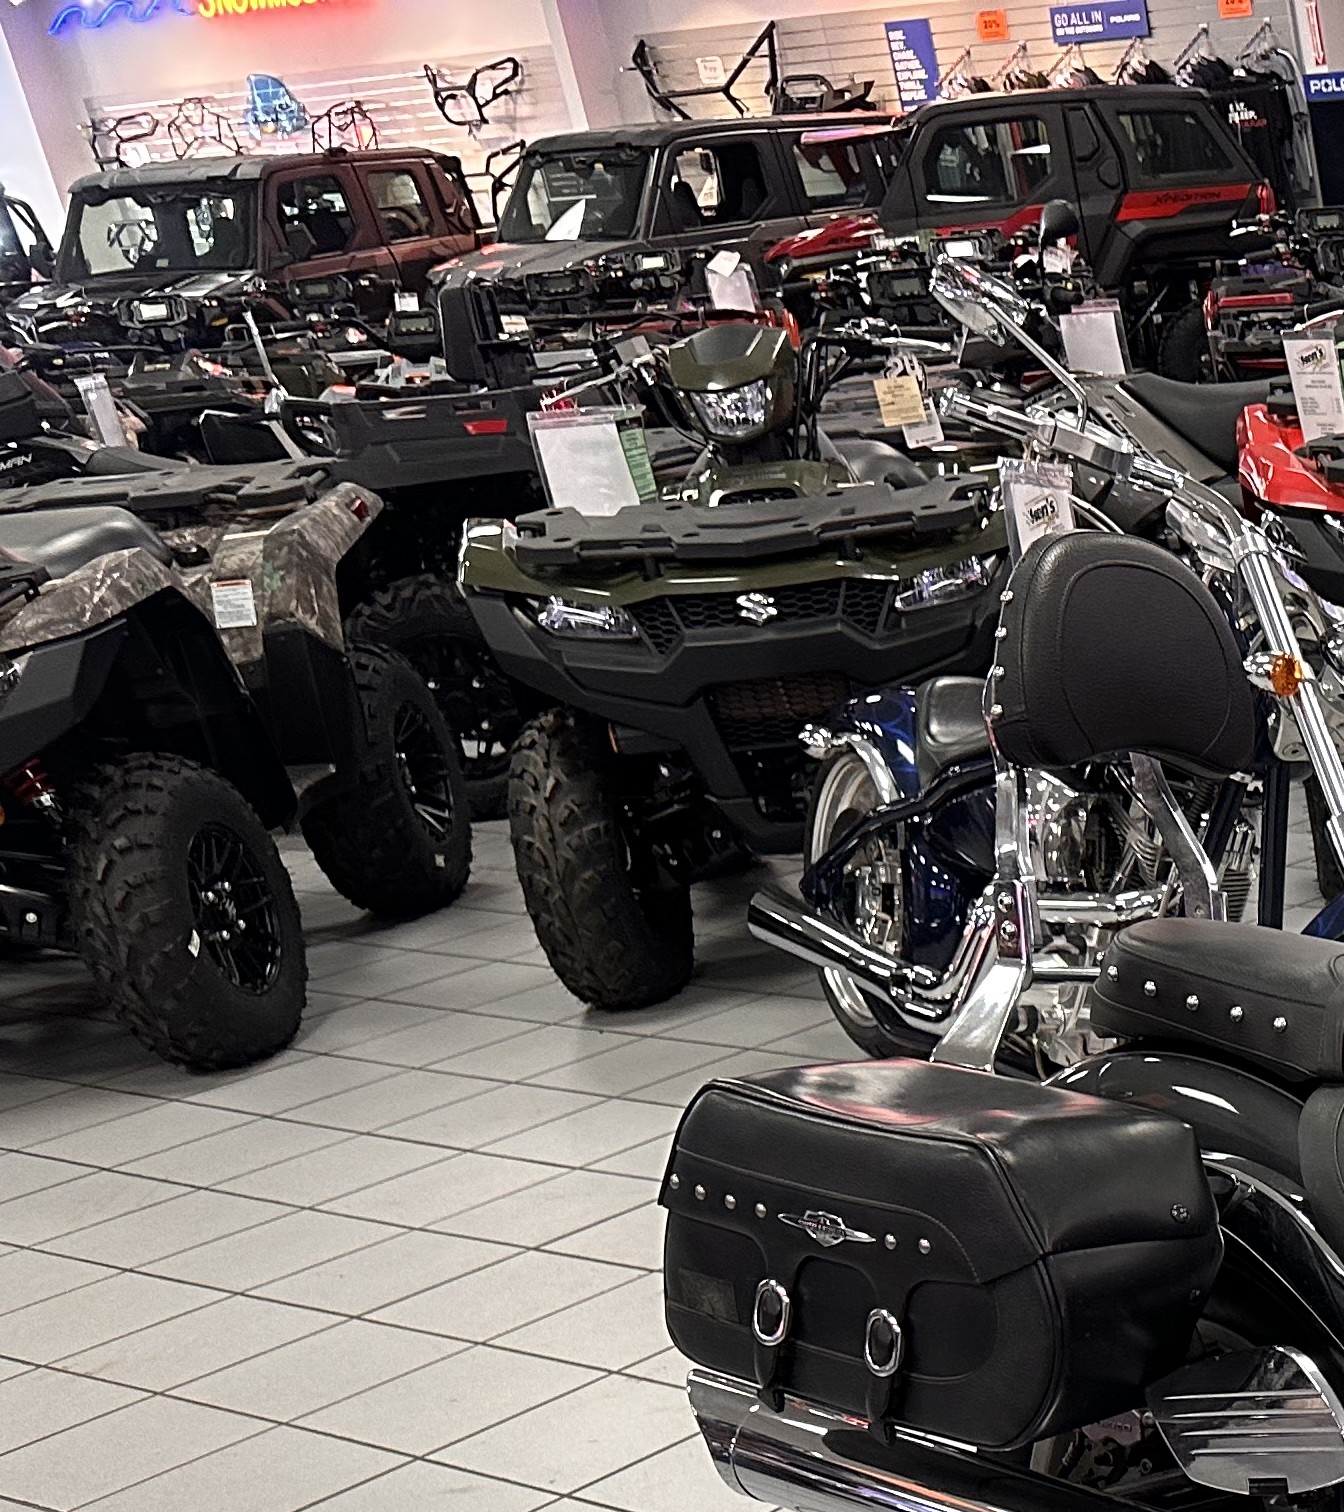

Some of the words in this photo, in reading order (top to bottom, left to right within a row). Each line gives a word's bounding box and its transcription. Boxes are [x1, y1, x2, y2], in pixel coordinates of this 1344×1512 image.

[1054, 12, 1068, 28] GO
[1070, 11, 1090, 26] ALL
[1091, 9, 1103, 24] IN
